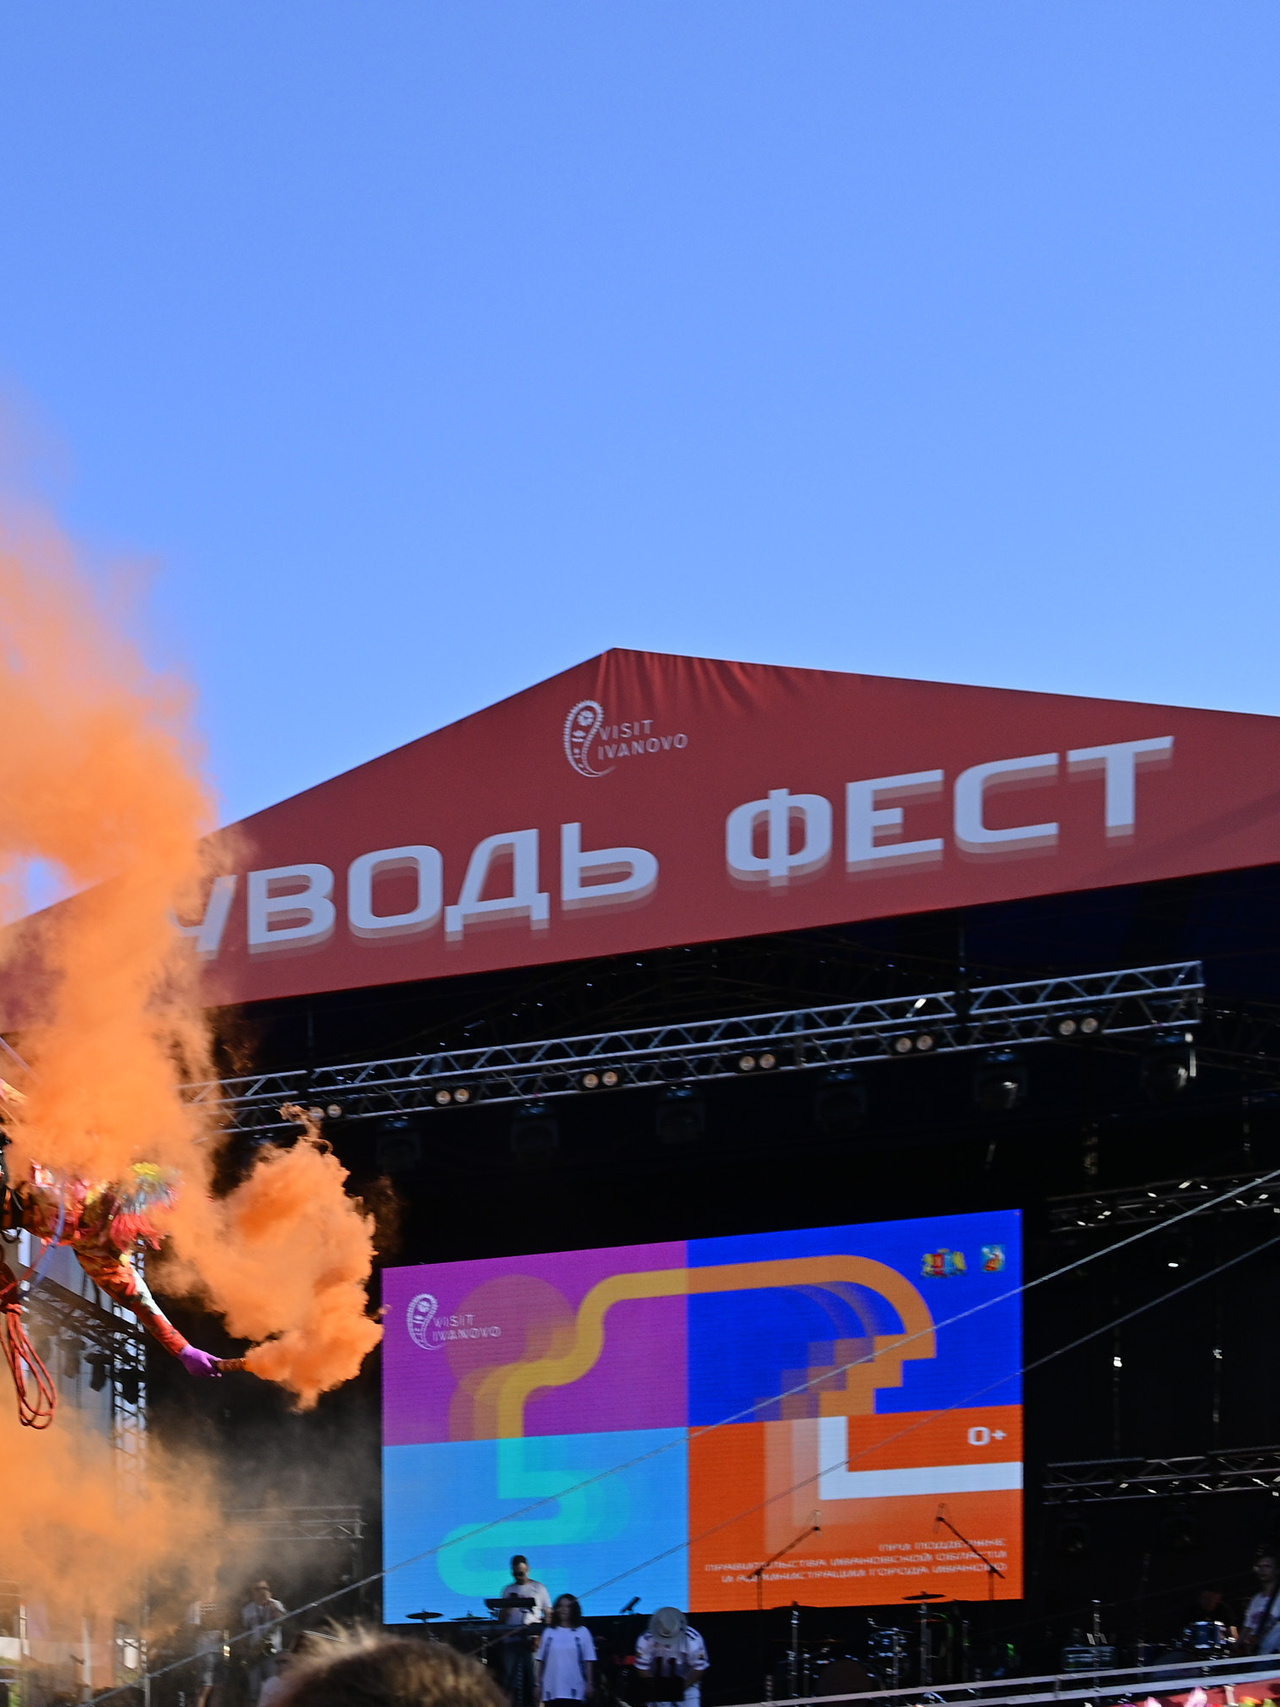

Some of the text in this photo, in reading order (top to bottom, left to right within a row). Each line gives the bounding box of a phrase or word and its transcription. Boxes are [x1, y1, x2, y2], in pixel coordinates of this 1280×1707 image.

[599, 719, 655, 741] VISIT
[597, 733, 689, 760] IVANOVO
[725, 735, 1175, 884] ФЕСТ
[433, 1314, 476, 1328] VISIT
[432, 1325, 502, 1341] IVANOVO
[967, 1426, 1008, 1446] 0+
